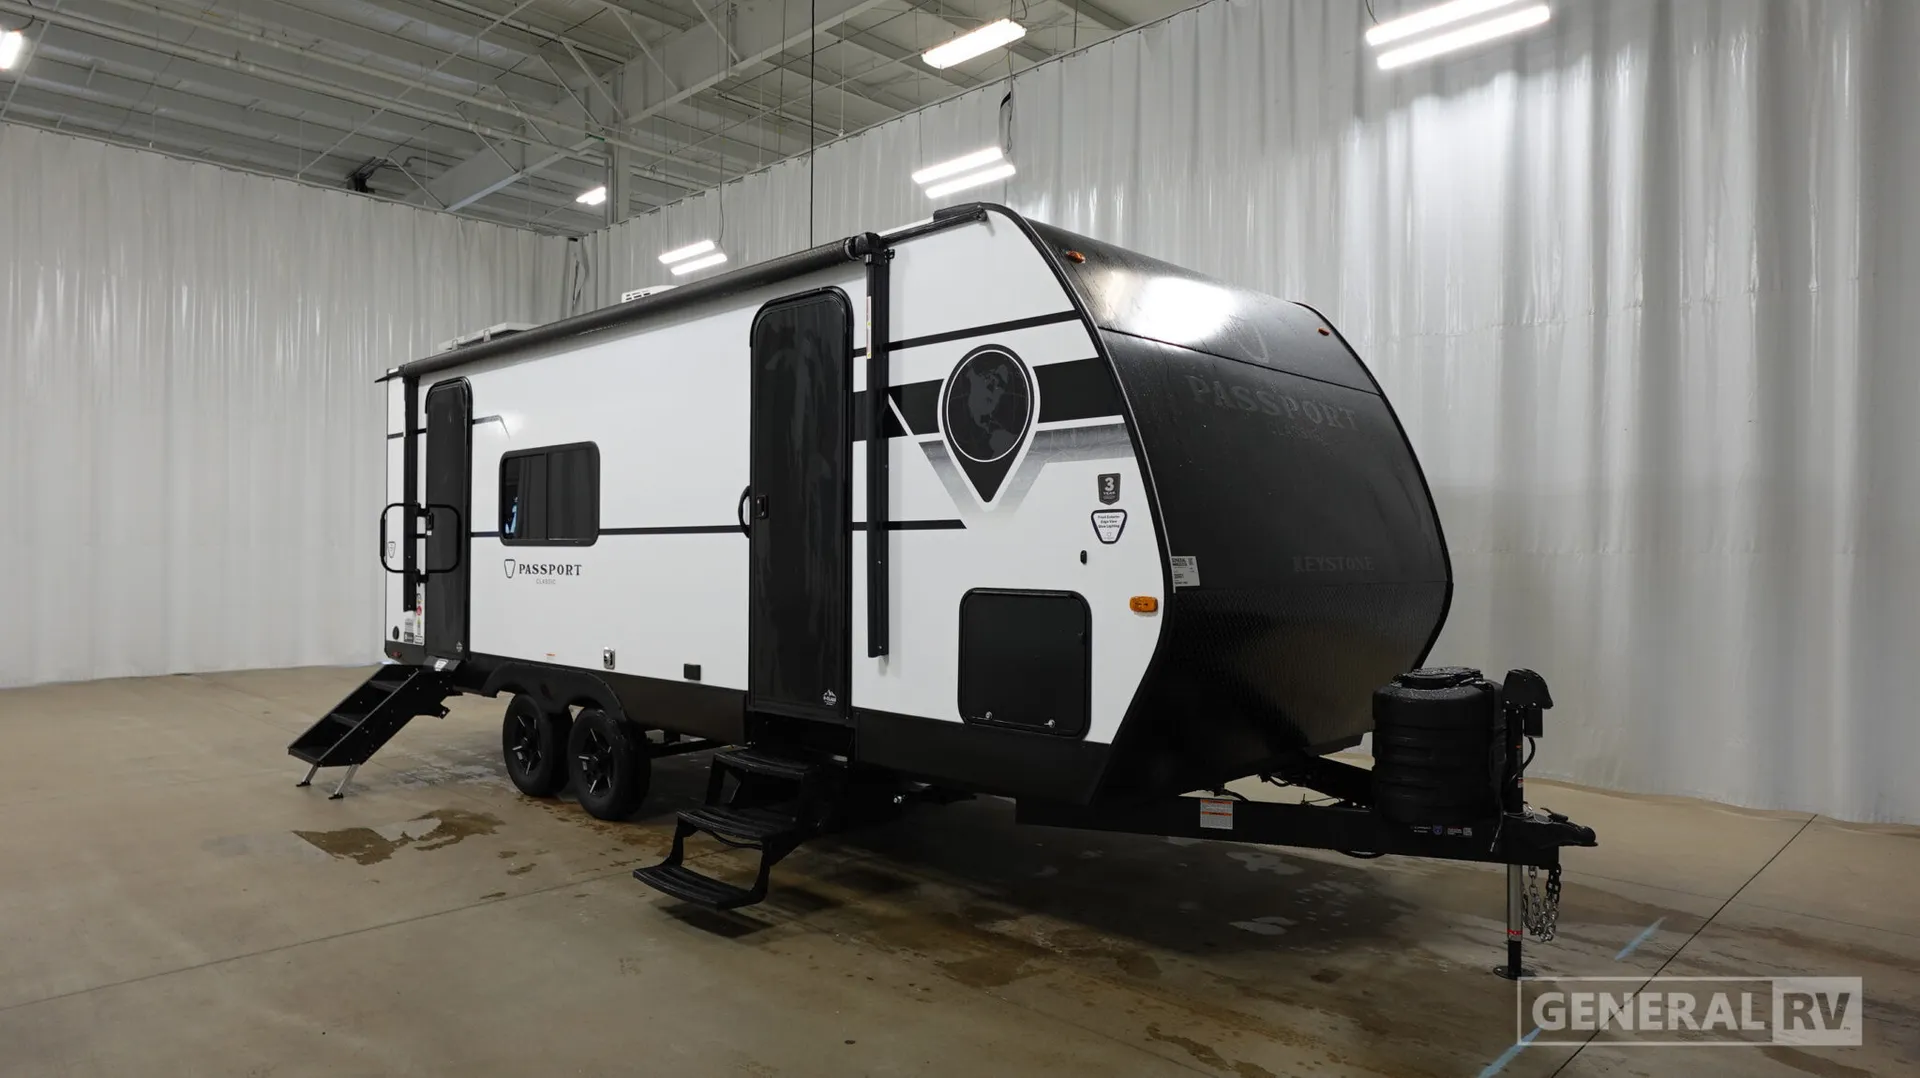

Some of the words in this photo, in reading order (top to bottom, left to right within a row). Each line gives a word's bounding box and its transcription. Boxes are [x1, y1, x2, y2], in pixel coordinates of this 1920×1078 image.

[1184, 374, 1359, 431] PASSPORT
[1104, 477, 1115, 491] 3
[519, 563, 582, 576] PASSPORT
[1291, 554, 1375, 573] KEYSTONE
